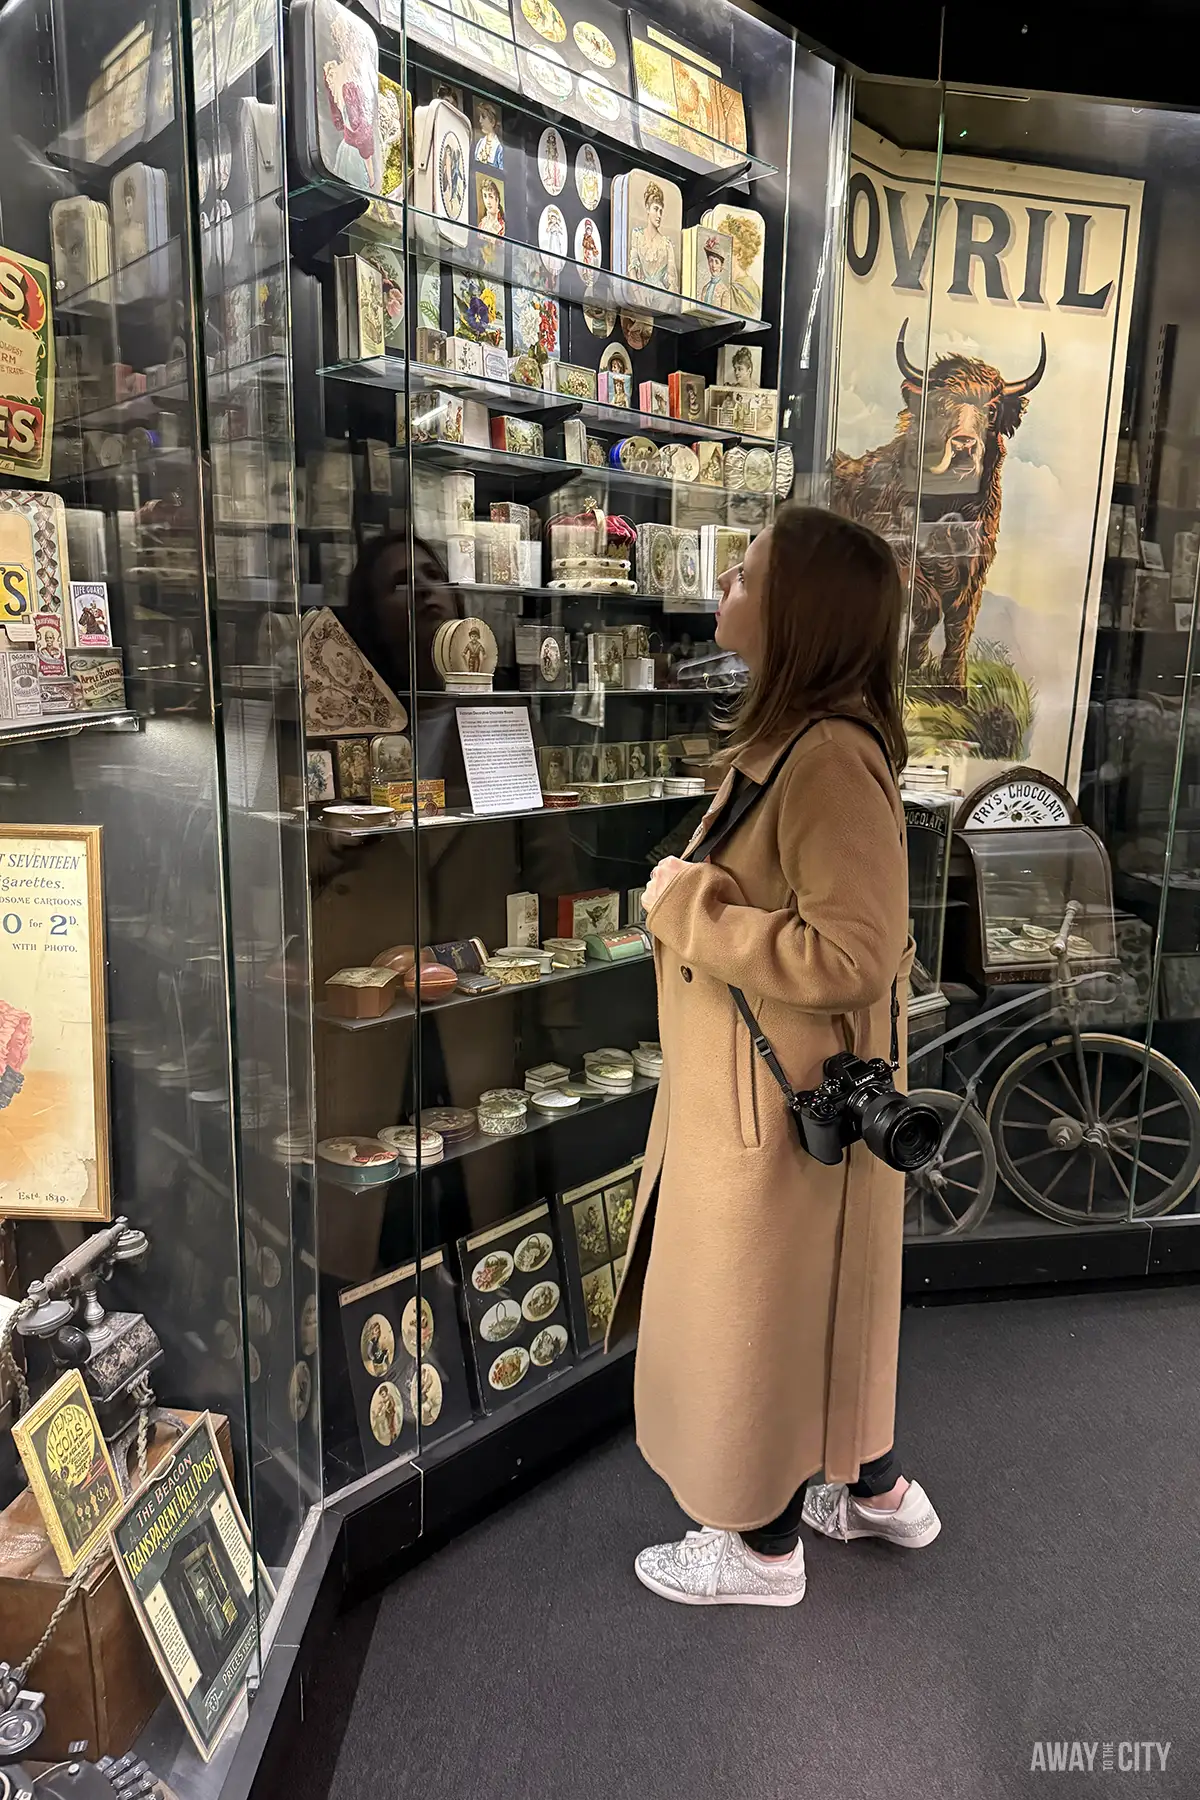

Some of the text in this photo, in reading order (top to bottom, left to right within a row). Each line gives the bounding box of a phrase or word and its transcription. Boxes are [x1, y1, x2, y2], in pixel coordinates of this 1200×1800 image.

[972, 783, 1066, 825] FRY'S CHOCOLATE
[34, 897, 83, 906] CARTOONS
[29, 918, 43, 928] for
[12, 943, 78, 953] WITH PHOTO.
[56, 1422, 84, 1457] COILS
[136, 1453, 193, 1528] THE BEACON
[222, 1653, 244, 1686] PRICES
